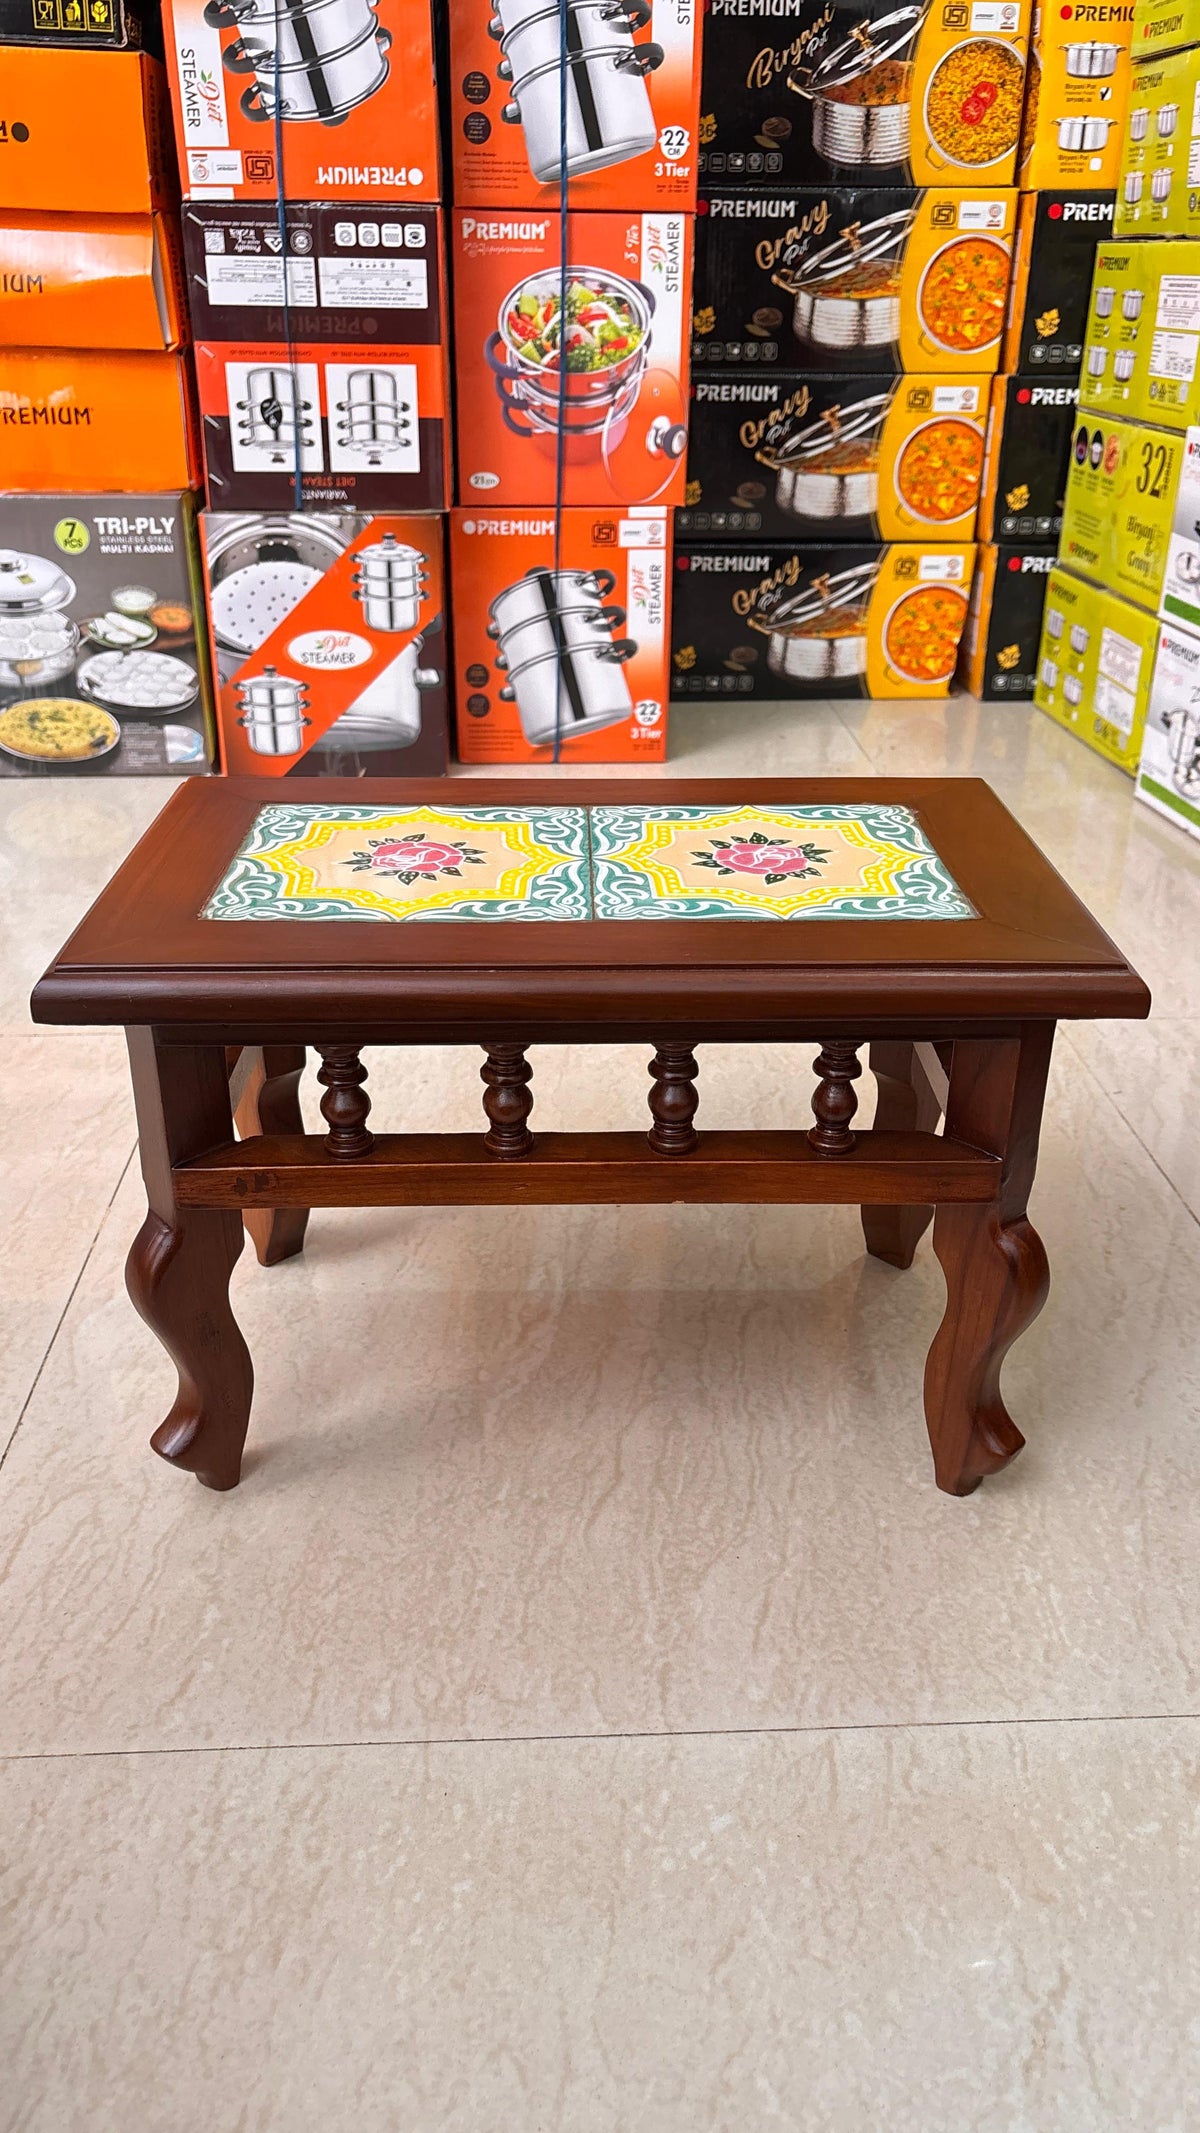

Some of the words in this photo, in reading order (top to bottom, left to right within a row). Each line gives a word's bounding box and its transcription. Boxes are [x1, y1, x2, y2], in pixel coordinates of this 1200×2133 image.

[711, 0, 800, 16] PREMIUM
[1149, 14, 1184, 38] PREMIUM
[746, 2, 836, 89] Biryani
[805, 28, 829, 57] Pot
[181, 48, 201, 128] STEAMER
[198, 79, 224, 129] Diet
[664, 129, 685, 147] 22
[318, 166, 408, 186] PREMIUM
[709, 199, 796, 218] PREMIUM
[1063, 203, 1113, 221] PREM
[462, 217, 546, 240] PREMIUM
[755, 200, 832, 270] Gravy
[646, 222, 668, 263] Diet
[665, 221, 680, 293] STEAMER
[3, 274, 43, 293] IUM
[695, 383, 779, 402] PREMIUM
[1031, 387, 1080, 406] PREM
[739, 385, 813, 449] Gravy
[1136, 441, 1167, 498] 32
[288, 477, 334, 487] STEAMR
[65, 522, 77, 538] 7
[93, 517, 175, 535] TRI-PLY
[477, 519, 556, 536] PREMIUM
[64, 538, 83, 548] PCS
[100, 535, 145, 544] STAINLESS
[147, 535, 174, 544] STEEL
[100, 544, 133, 554] MULTI
[689, 555, 771, 572] PREMIUM
[648, 564, 662, 624] STEAMER
[731, 555, 804, 616] Gravy
[301, 651, 356, 664] STEAMER
[640, 703, 657, 716] 22
